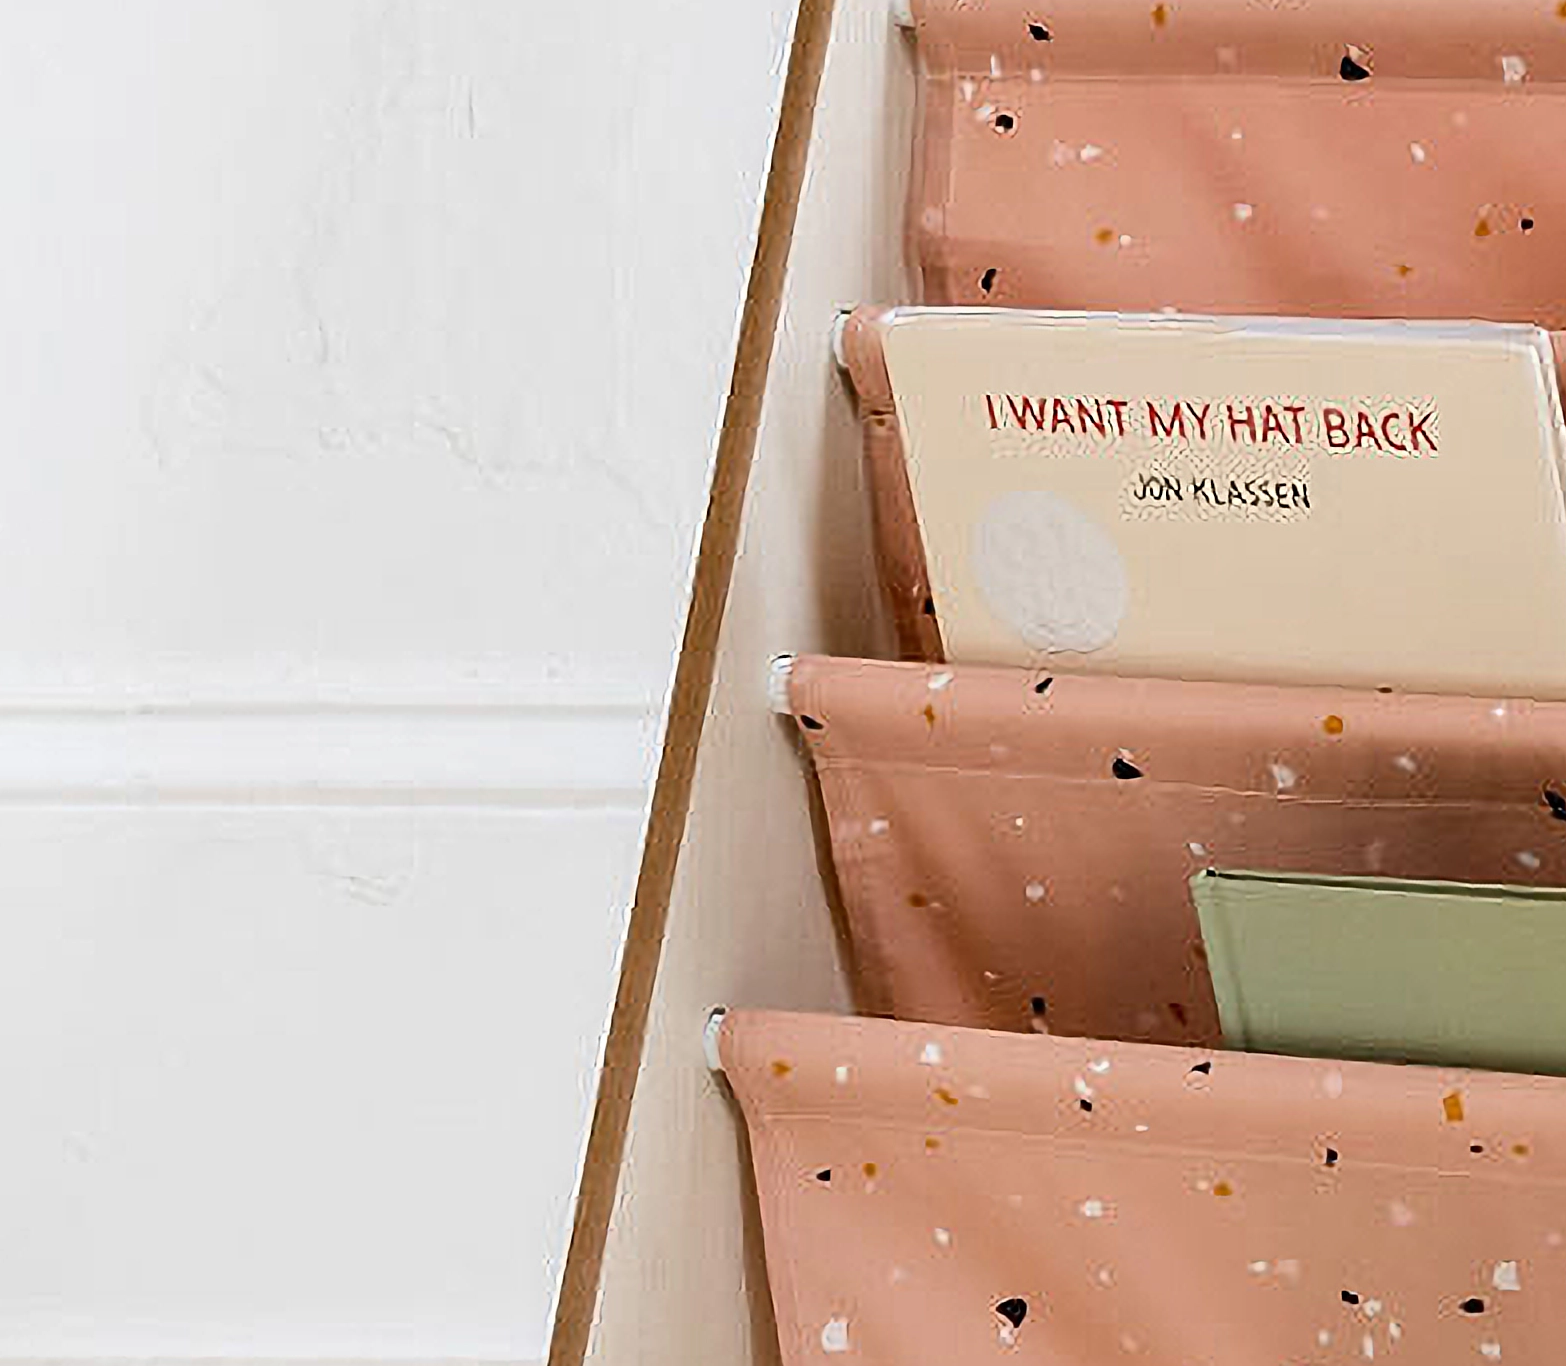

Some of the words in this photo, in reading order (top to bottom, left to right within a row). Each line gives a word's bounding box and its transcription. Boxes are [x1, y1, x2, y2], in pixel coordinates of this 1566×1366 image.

[984, 393, 999, 432] I
[1006, 395, 1129, 438] WANT
[1145, 401, 1211, 440] MY
[1227, 402, 1306, 445] HAT
[1323, 407, 1439, 454] BACK
[1133, 473, 1183, 502] JON
[1192, 477, 1311, 510] KLASSEN
